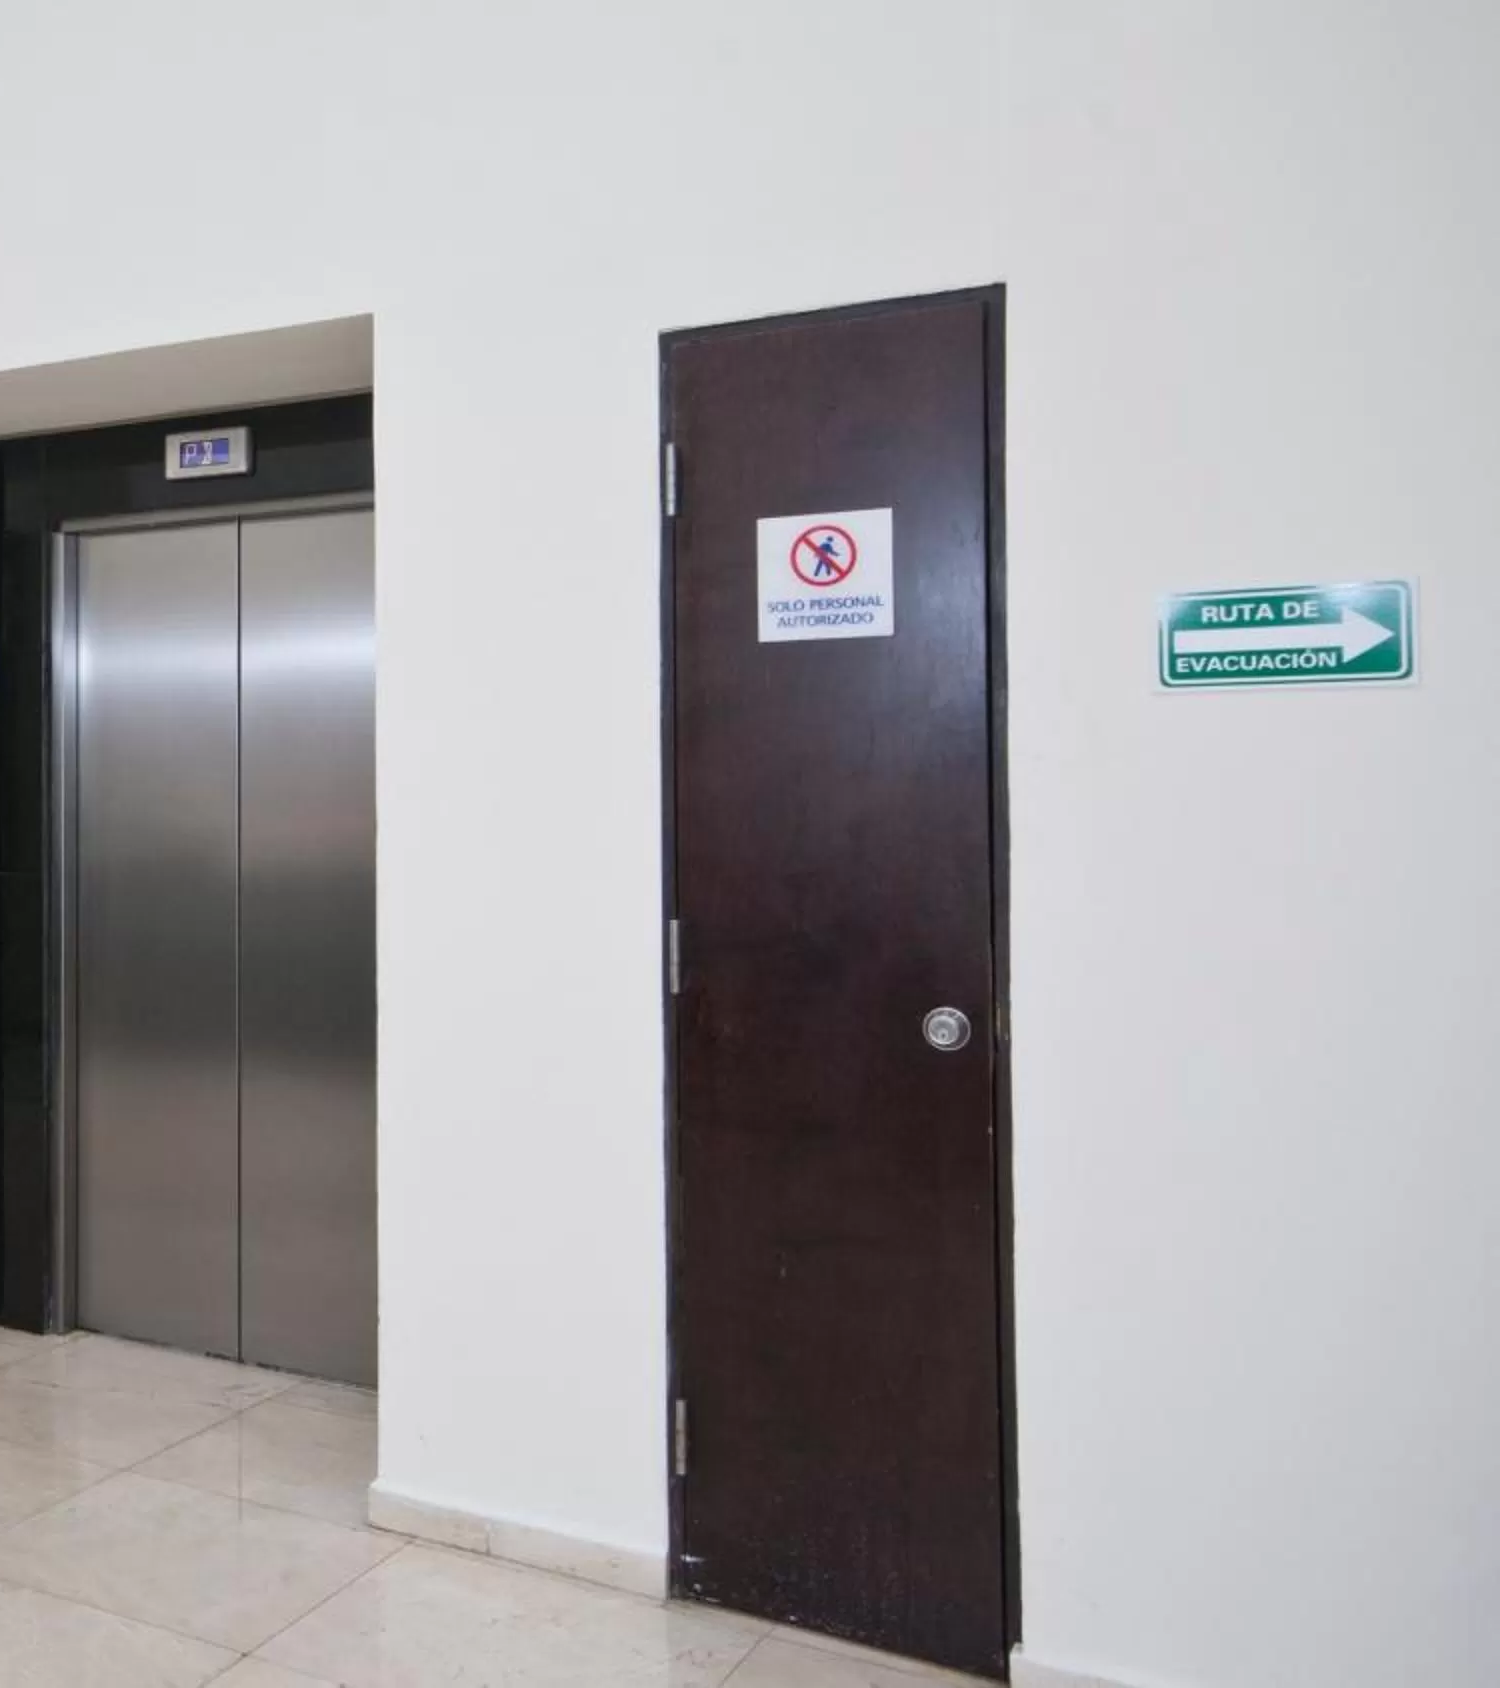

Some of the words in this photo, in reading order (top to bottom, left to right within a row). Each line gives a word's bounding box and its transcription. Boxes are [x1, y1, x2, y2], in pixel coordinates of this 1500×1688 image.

[767, 600, 805, 614] SOLO
[810, 595, 885, 611] PERSONAL
[1201, 603, 1275, 624] RUTA
[1282, 601, 1321, 620] DE
[777, 611, 876, 629] AUTORIZADO
[1175, 650, 1337, 673] EVACUACIÓN
